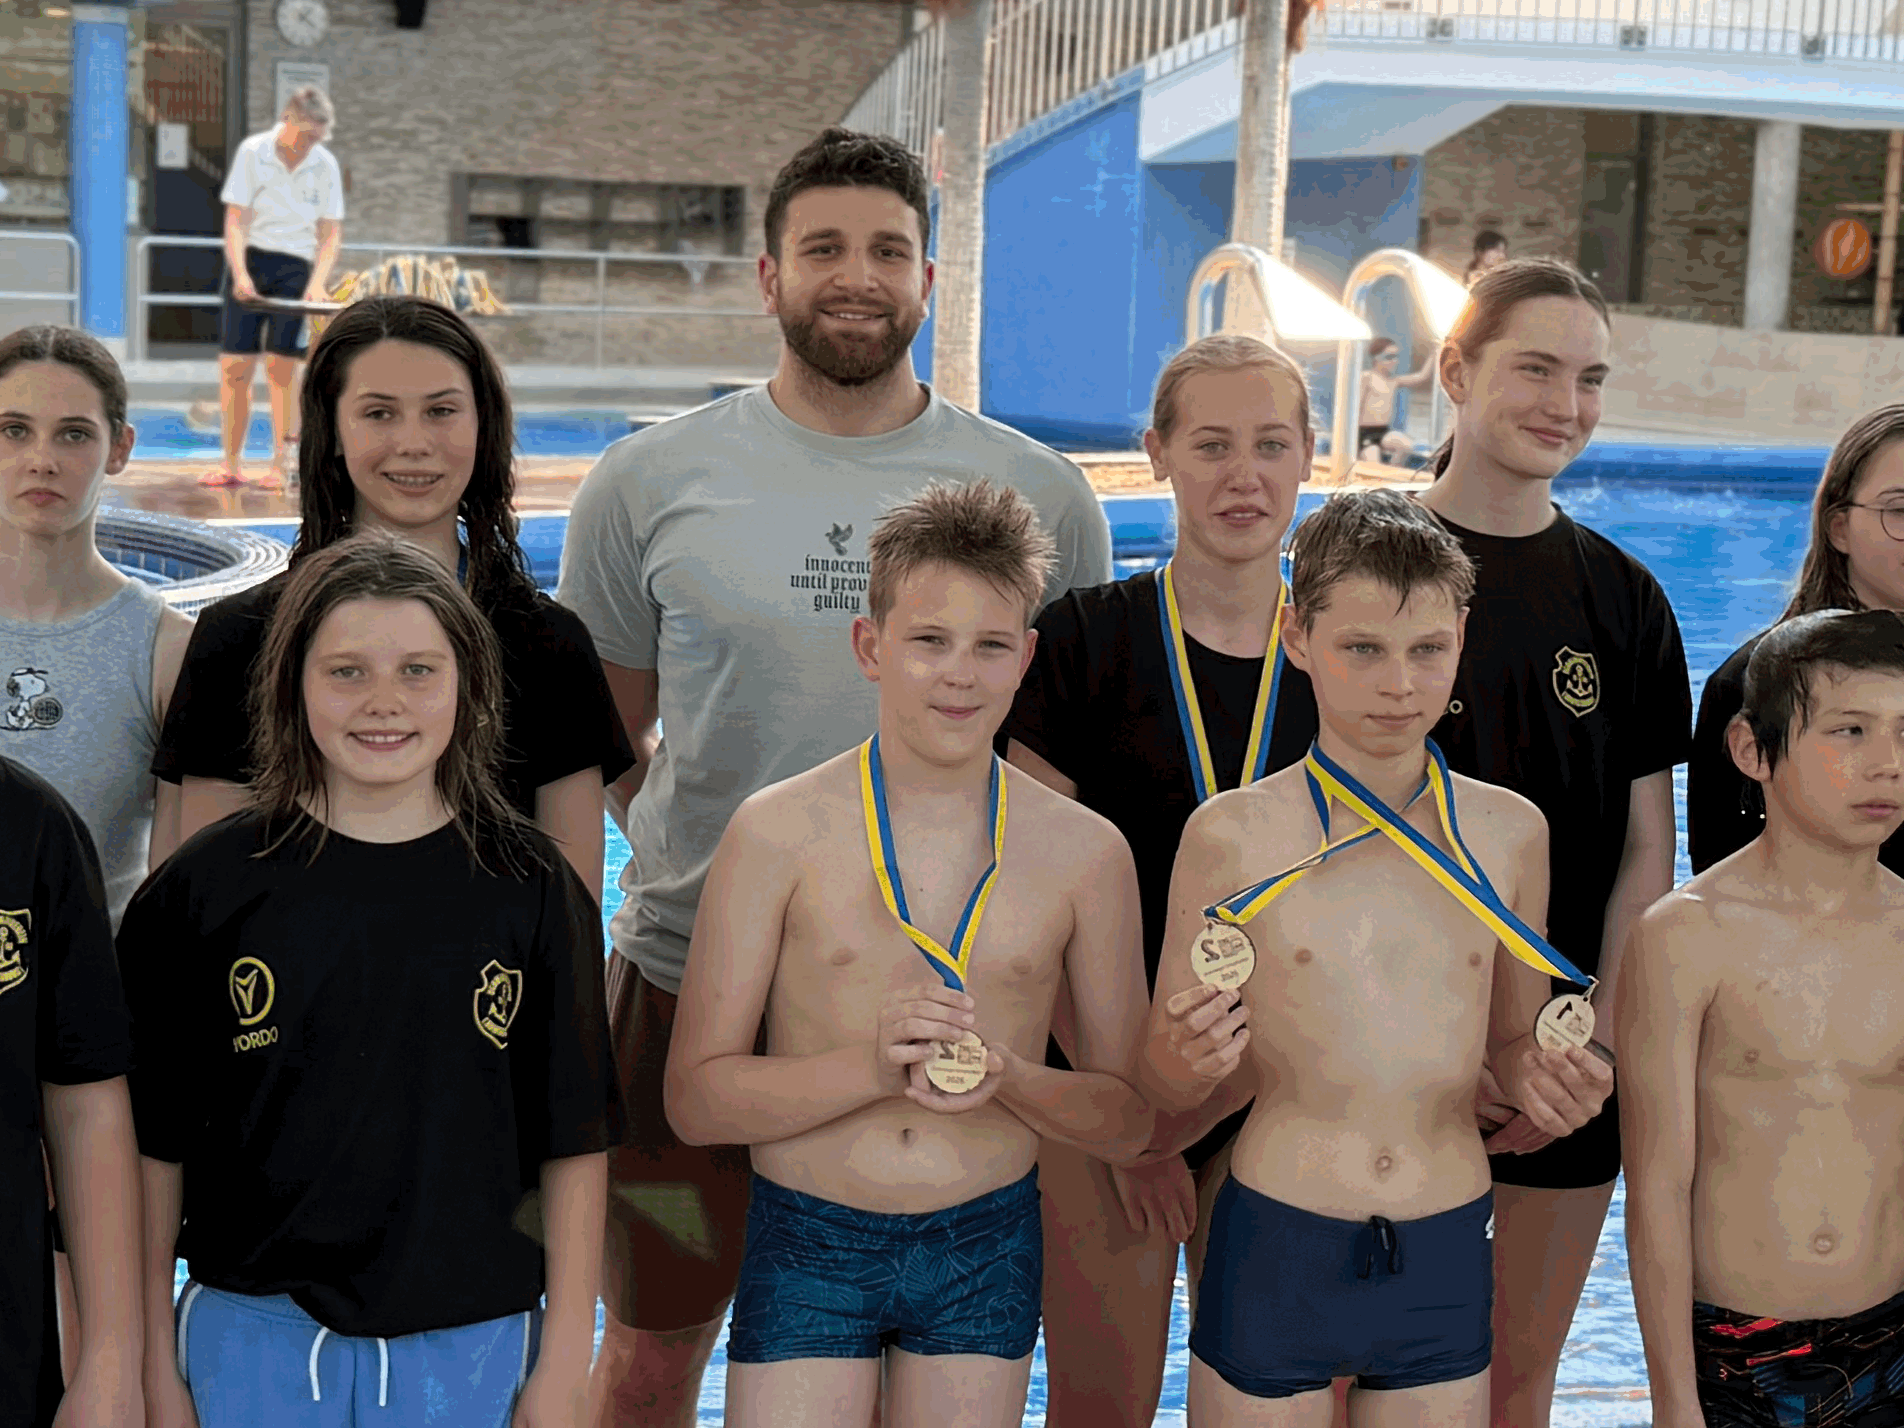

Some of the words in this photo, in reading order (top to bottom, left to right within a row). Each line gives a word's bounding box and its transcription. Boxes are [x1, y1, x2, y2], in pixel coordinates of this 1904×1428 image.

[805, 553, 871, 574] innocent
[790, 572, 827, 590] until
[830, 575, 867, 594] prov
[814, 591, 861, 614] guilty
